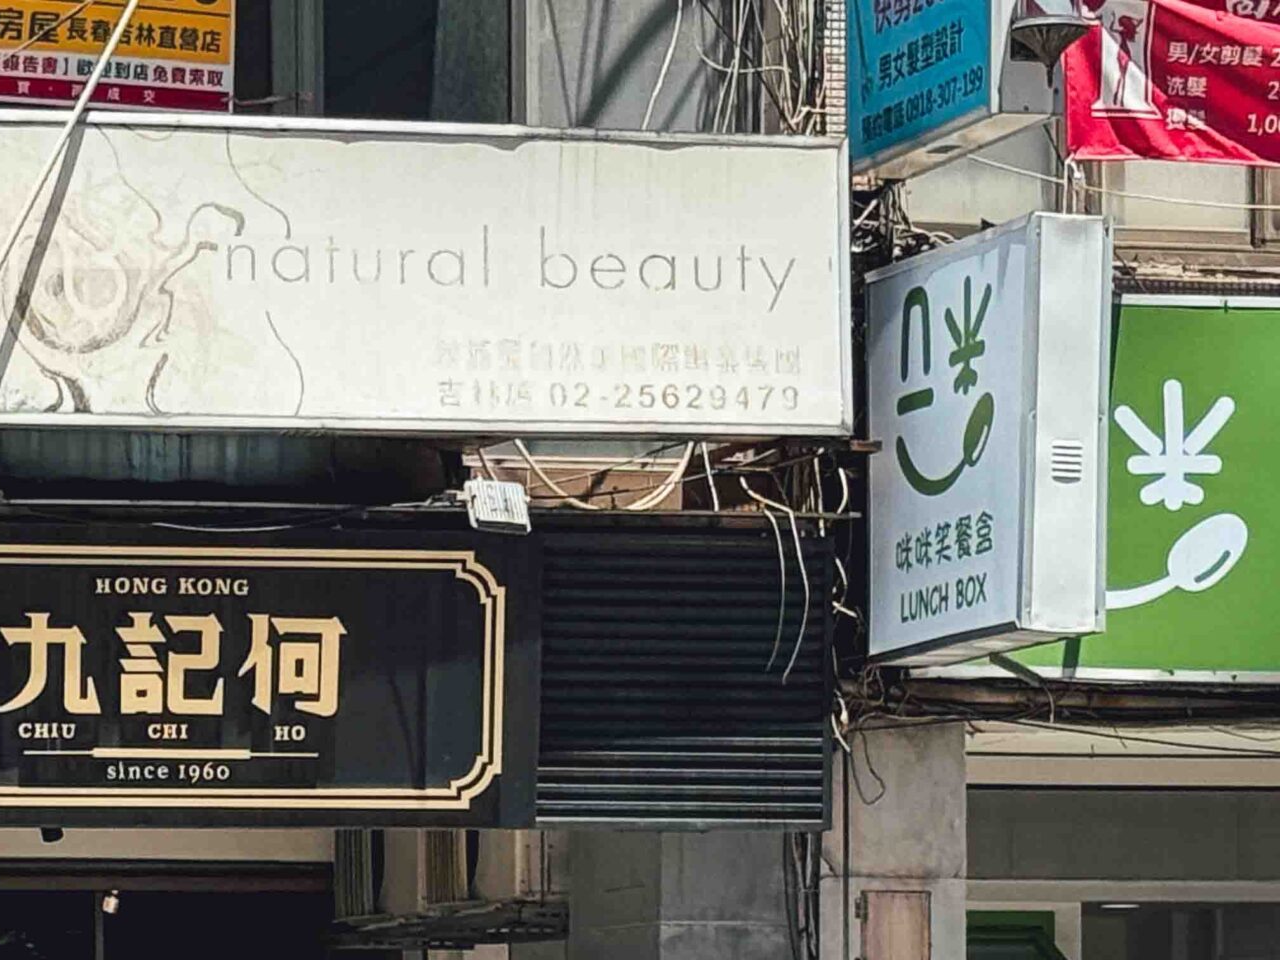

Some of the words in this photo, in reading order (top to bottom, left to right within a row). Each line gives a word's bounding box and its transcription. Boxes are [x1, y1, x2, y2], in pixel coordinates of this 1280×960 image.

[226, 225, 490, 286] natural
[539, 226, 796, 312] beauty
[549, 381, 799, 411] 02-25629479
[895, 511, 993, 574] 咪咪笑餐盒
[95, 577, 168, 595] HONG
[178, 578, 249, 596] KONG
[901, 581, 949, 623] LUNCH
[955, 572, 987, 610] BOX
[18, 722, 77, 739] CHIU
[147, 723, 189, 740] CHI
[274, 725, 306, 741] HO
[106, 761, 170, 780] since
[178, 763, 231, 784] 1960
